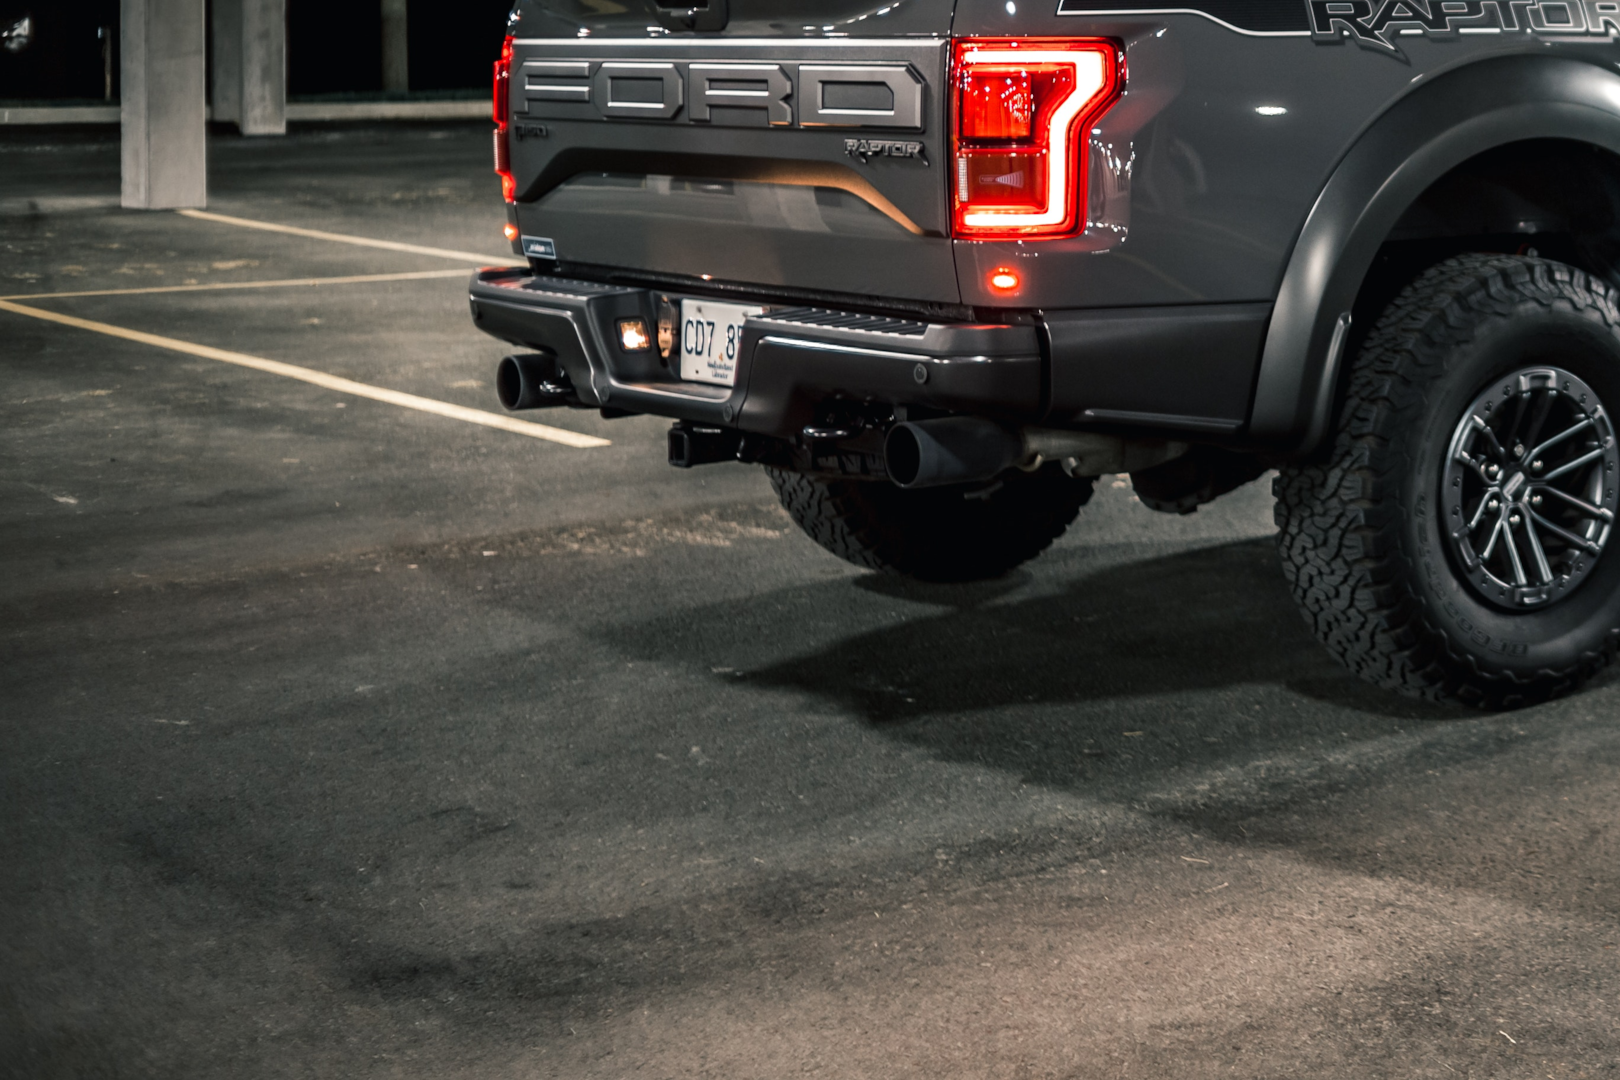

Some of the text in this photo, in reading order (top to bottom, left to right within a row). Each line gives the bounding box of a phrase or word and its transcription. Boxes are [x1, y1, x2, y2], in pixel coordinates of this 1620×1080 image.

[515, 60, 927, 131] FORD
[843, 138, 930, 167] RAPTOR
[684, 318, 715, 358] CD7
